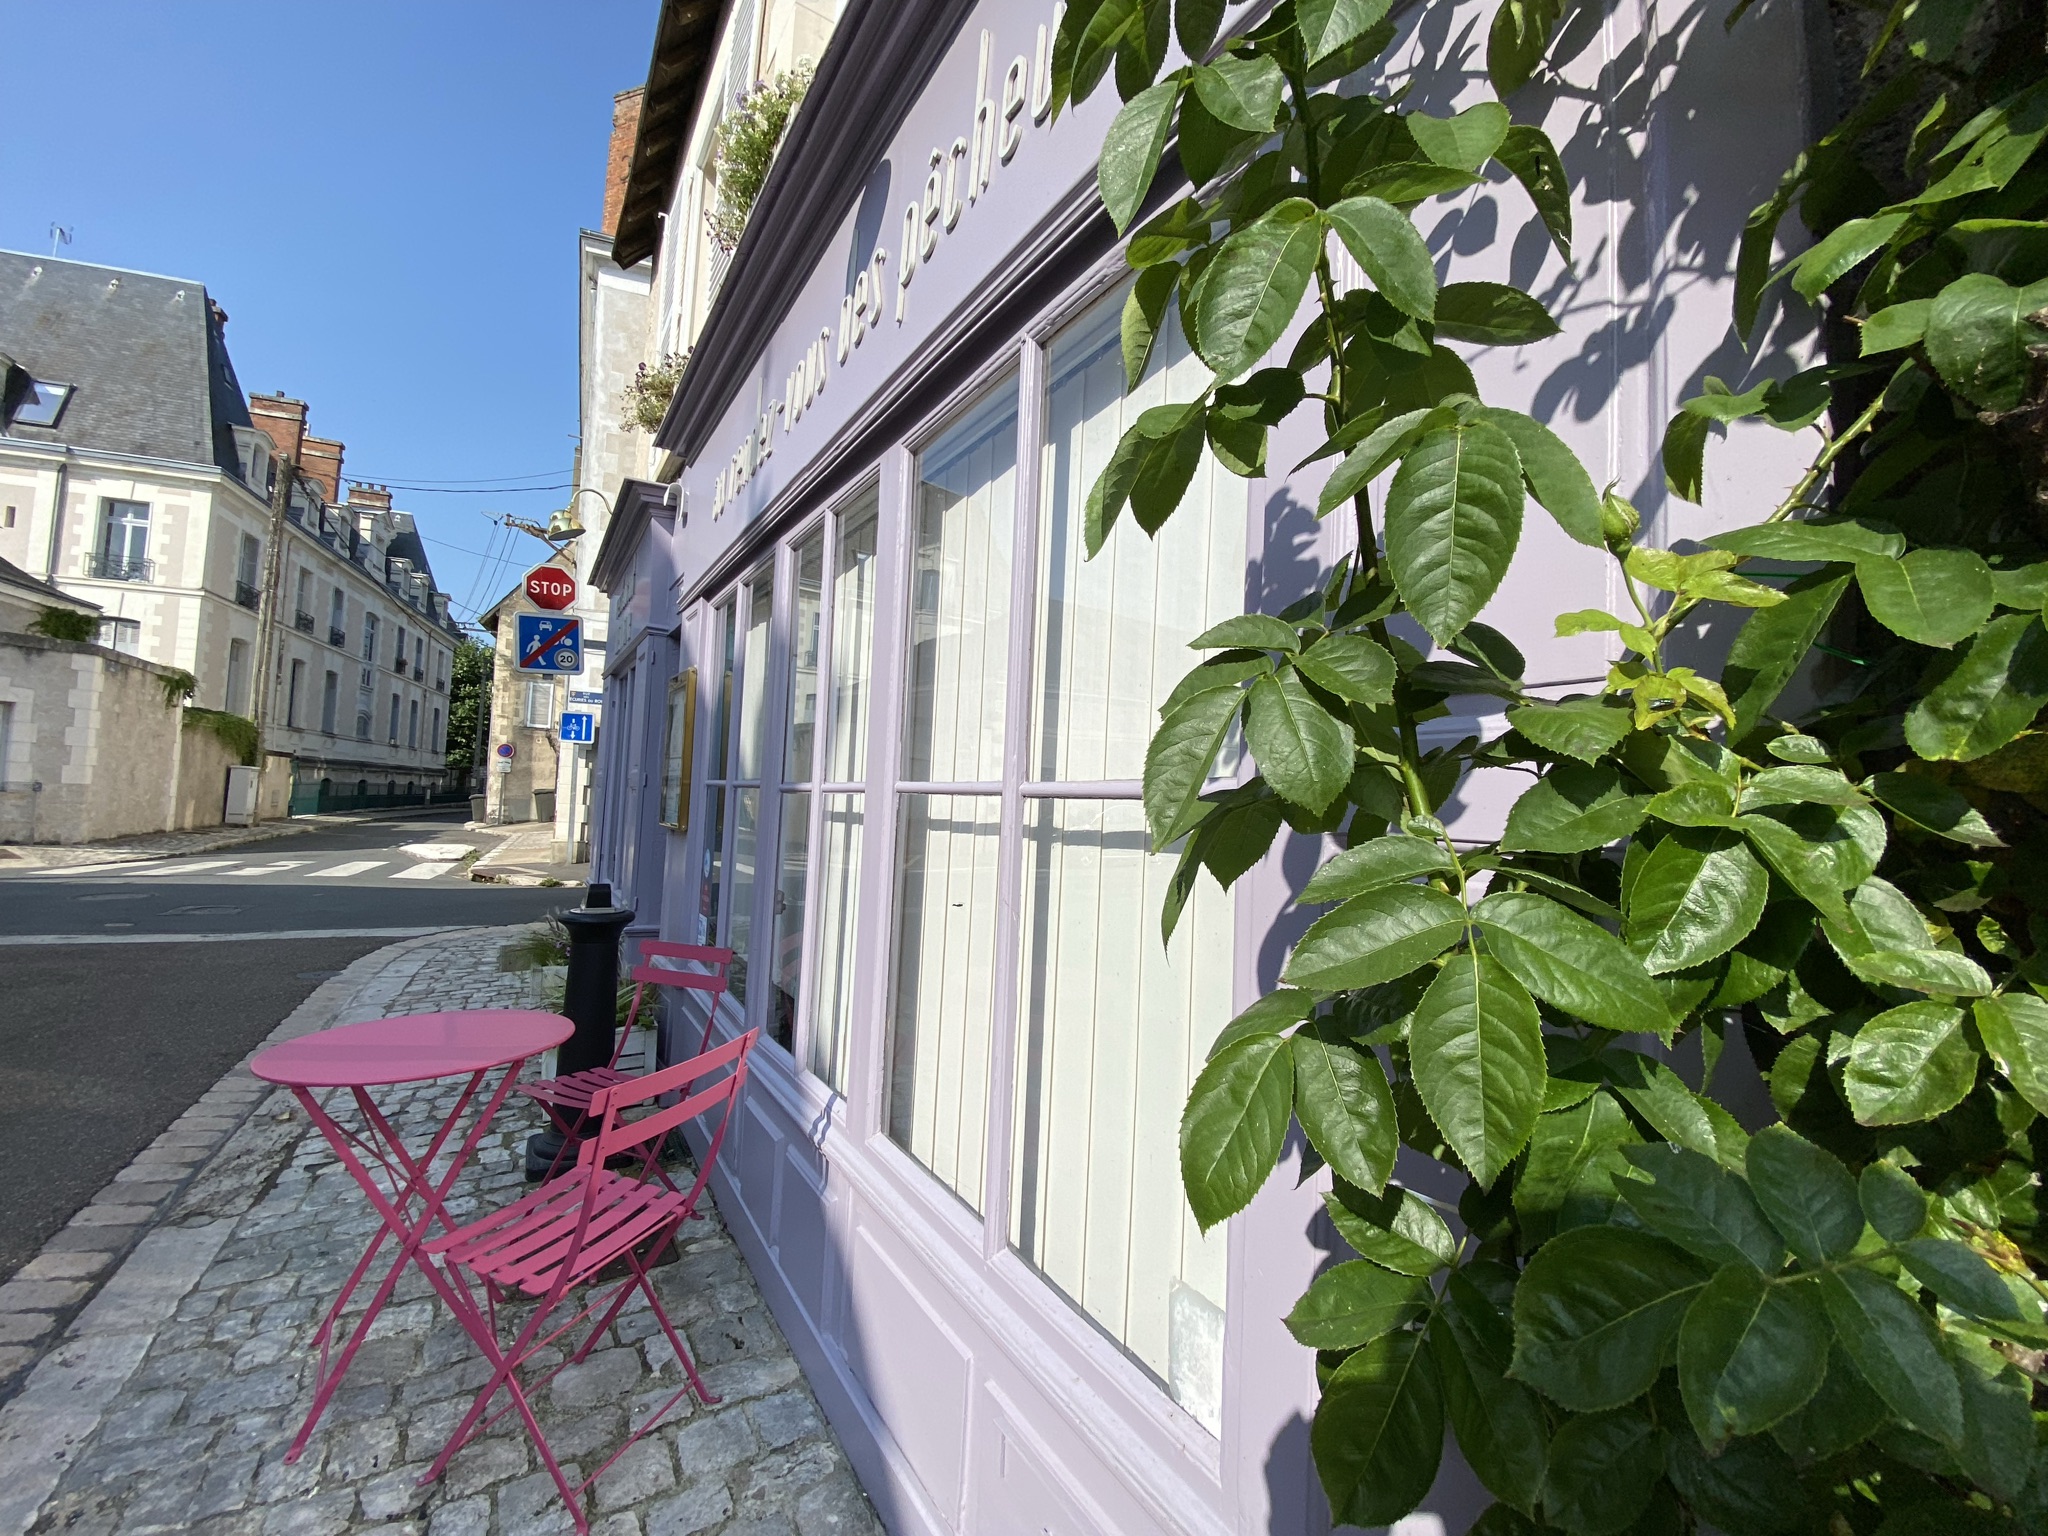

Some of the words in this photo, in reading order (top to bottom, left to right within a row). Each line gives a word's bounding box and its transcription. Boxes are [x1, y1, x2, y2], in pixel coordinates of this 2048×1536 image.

[895, 1, 1067, 328] pêcheu
[530, 580, 573, 597] STOP
[559, 655, 573, 664] 20
